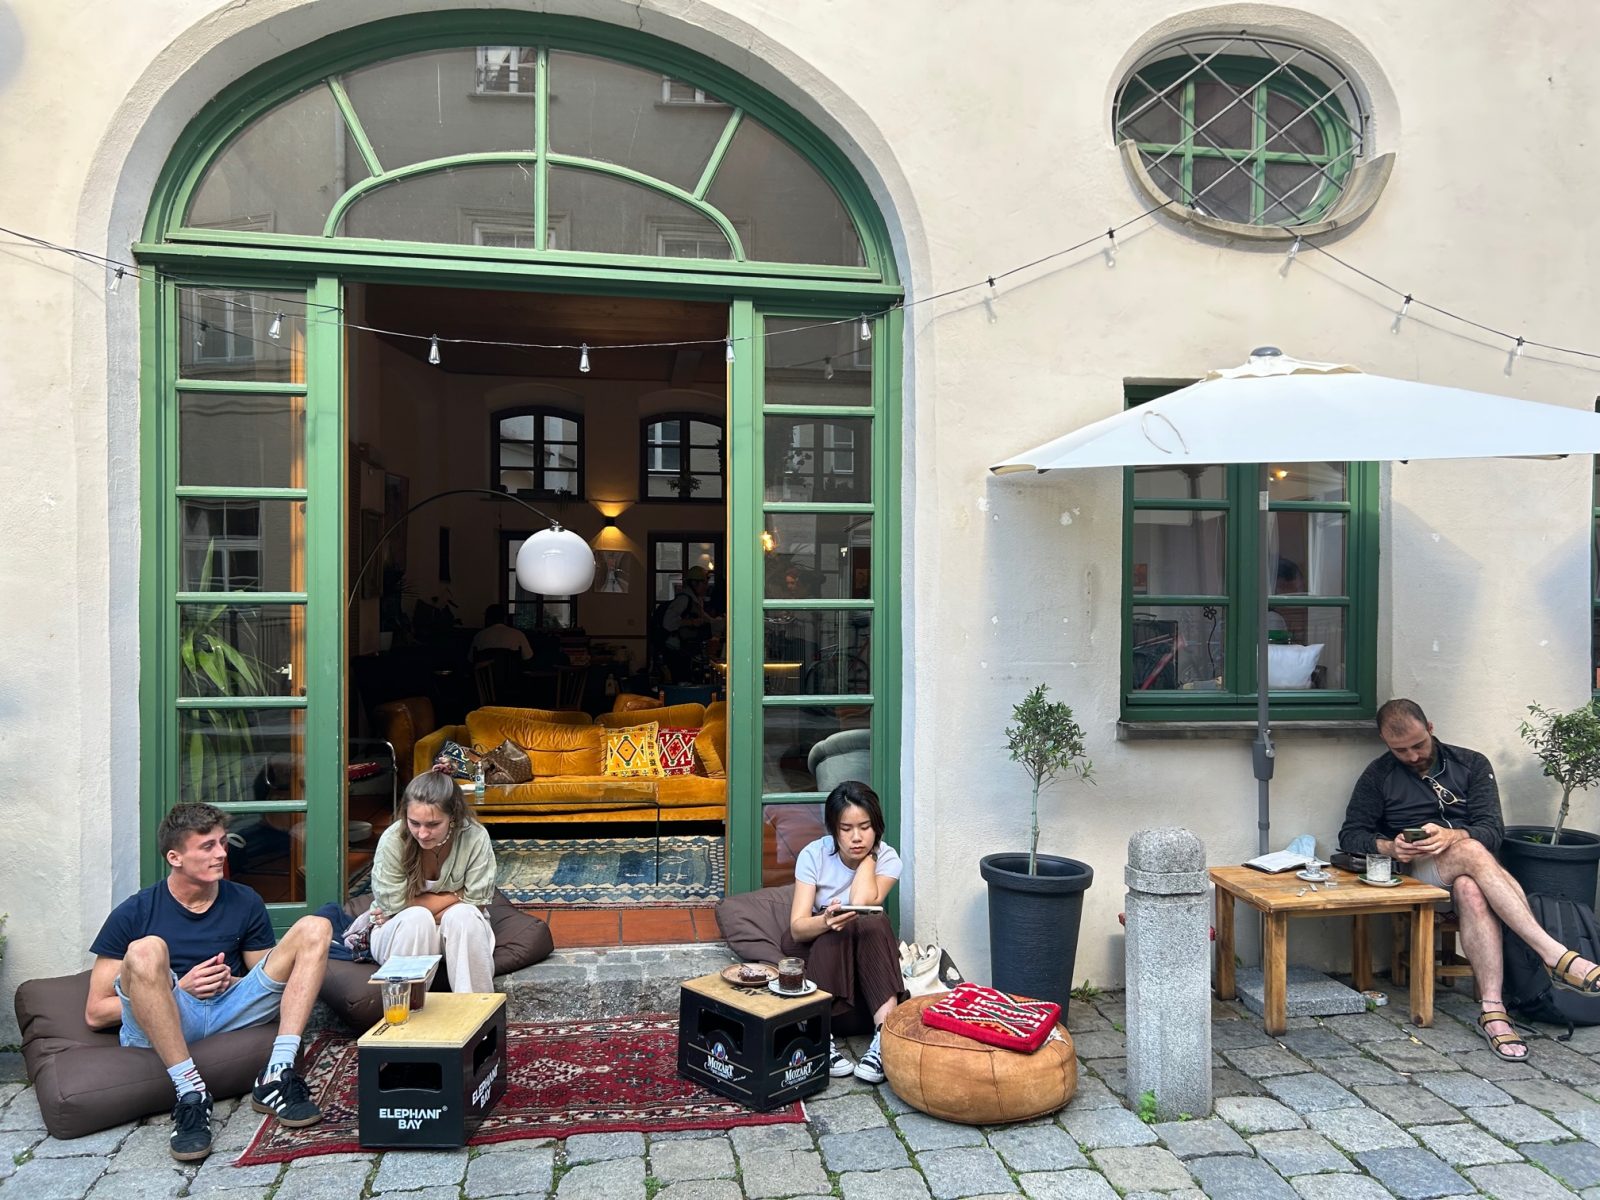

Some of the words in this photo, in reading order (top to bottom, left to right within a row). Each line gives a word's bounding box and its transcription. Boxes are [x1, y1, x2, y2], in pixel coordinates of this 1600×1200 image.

[785, 1061, 813, 1082] MOZART
[472, 1063, 499, 1106] ELEPHANT
[480, 1085, 492, 1109] BAY
[379, 1108, 442, 1120] ELEPHANT
[398, 1119, 423, 1130] BAY
